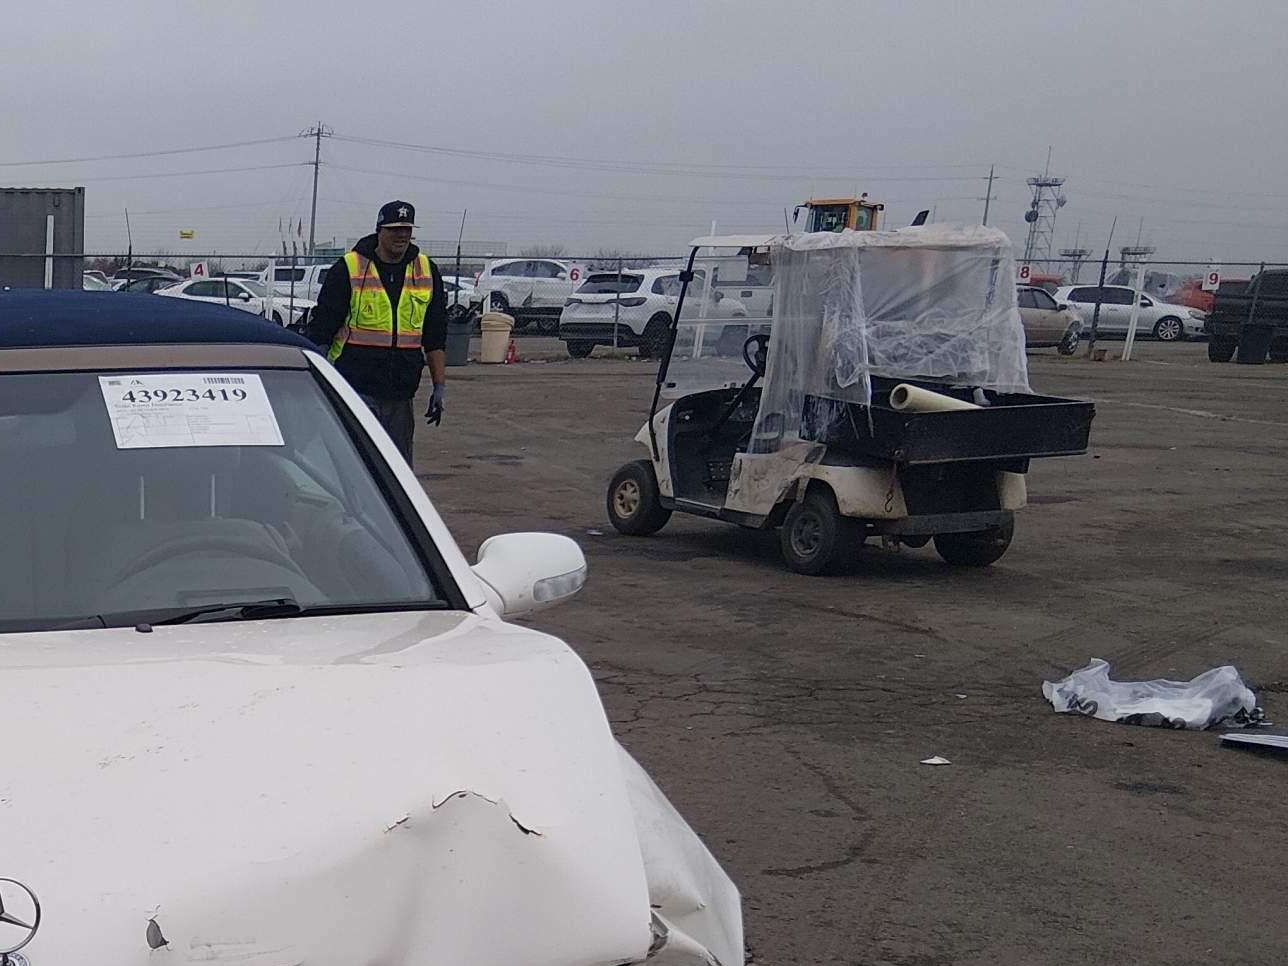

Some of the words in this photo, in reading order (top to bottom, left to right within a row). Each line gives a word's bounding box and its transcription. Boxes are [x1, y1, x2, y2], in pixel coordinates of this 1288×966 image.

[194, 263, 204, 277] 4
[570, 268, 580, 281] 6
[1020, 266, 1030, 279] 8
[1209, 272, 1219, 285] 9
[122, 388, 248, 403] 43923419
